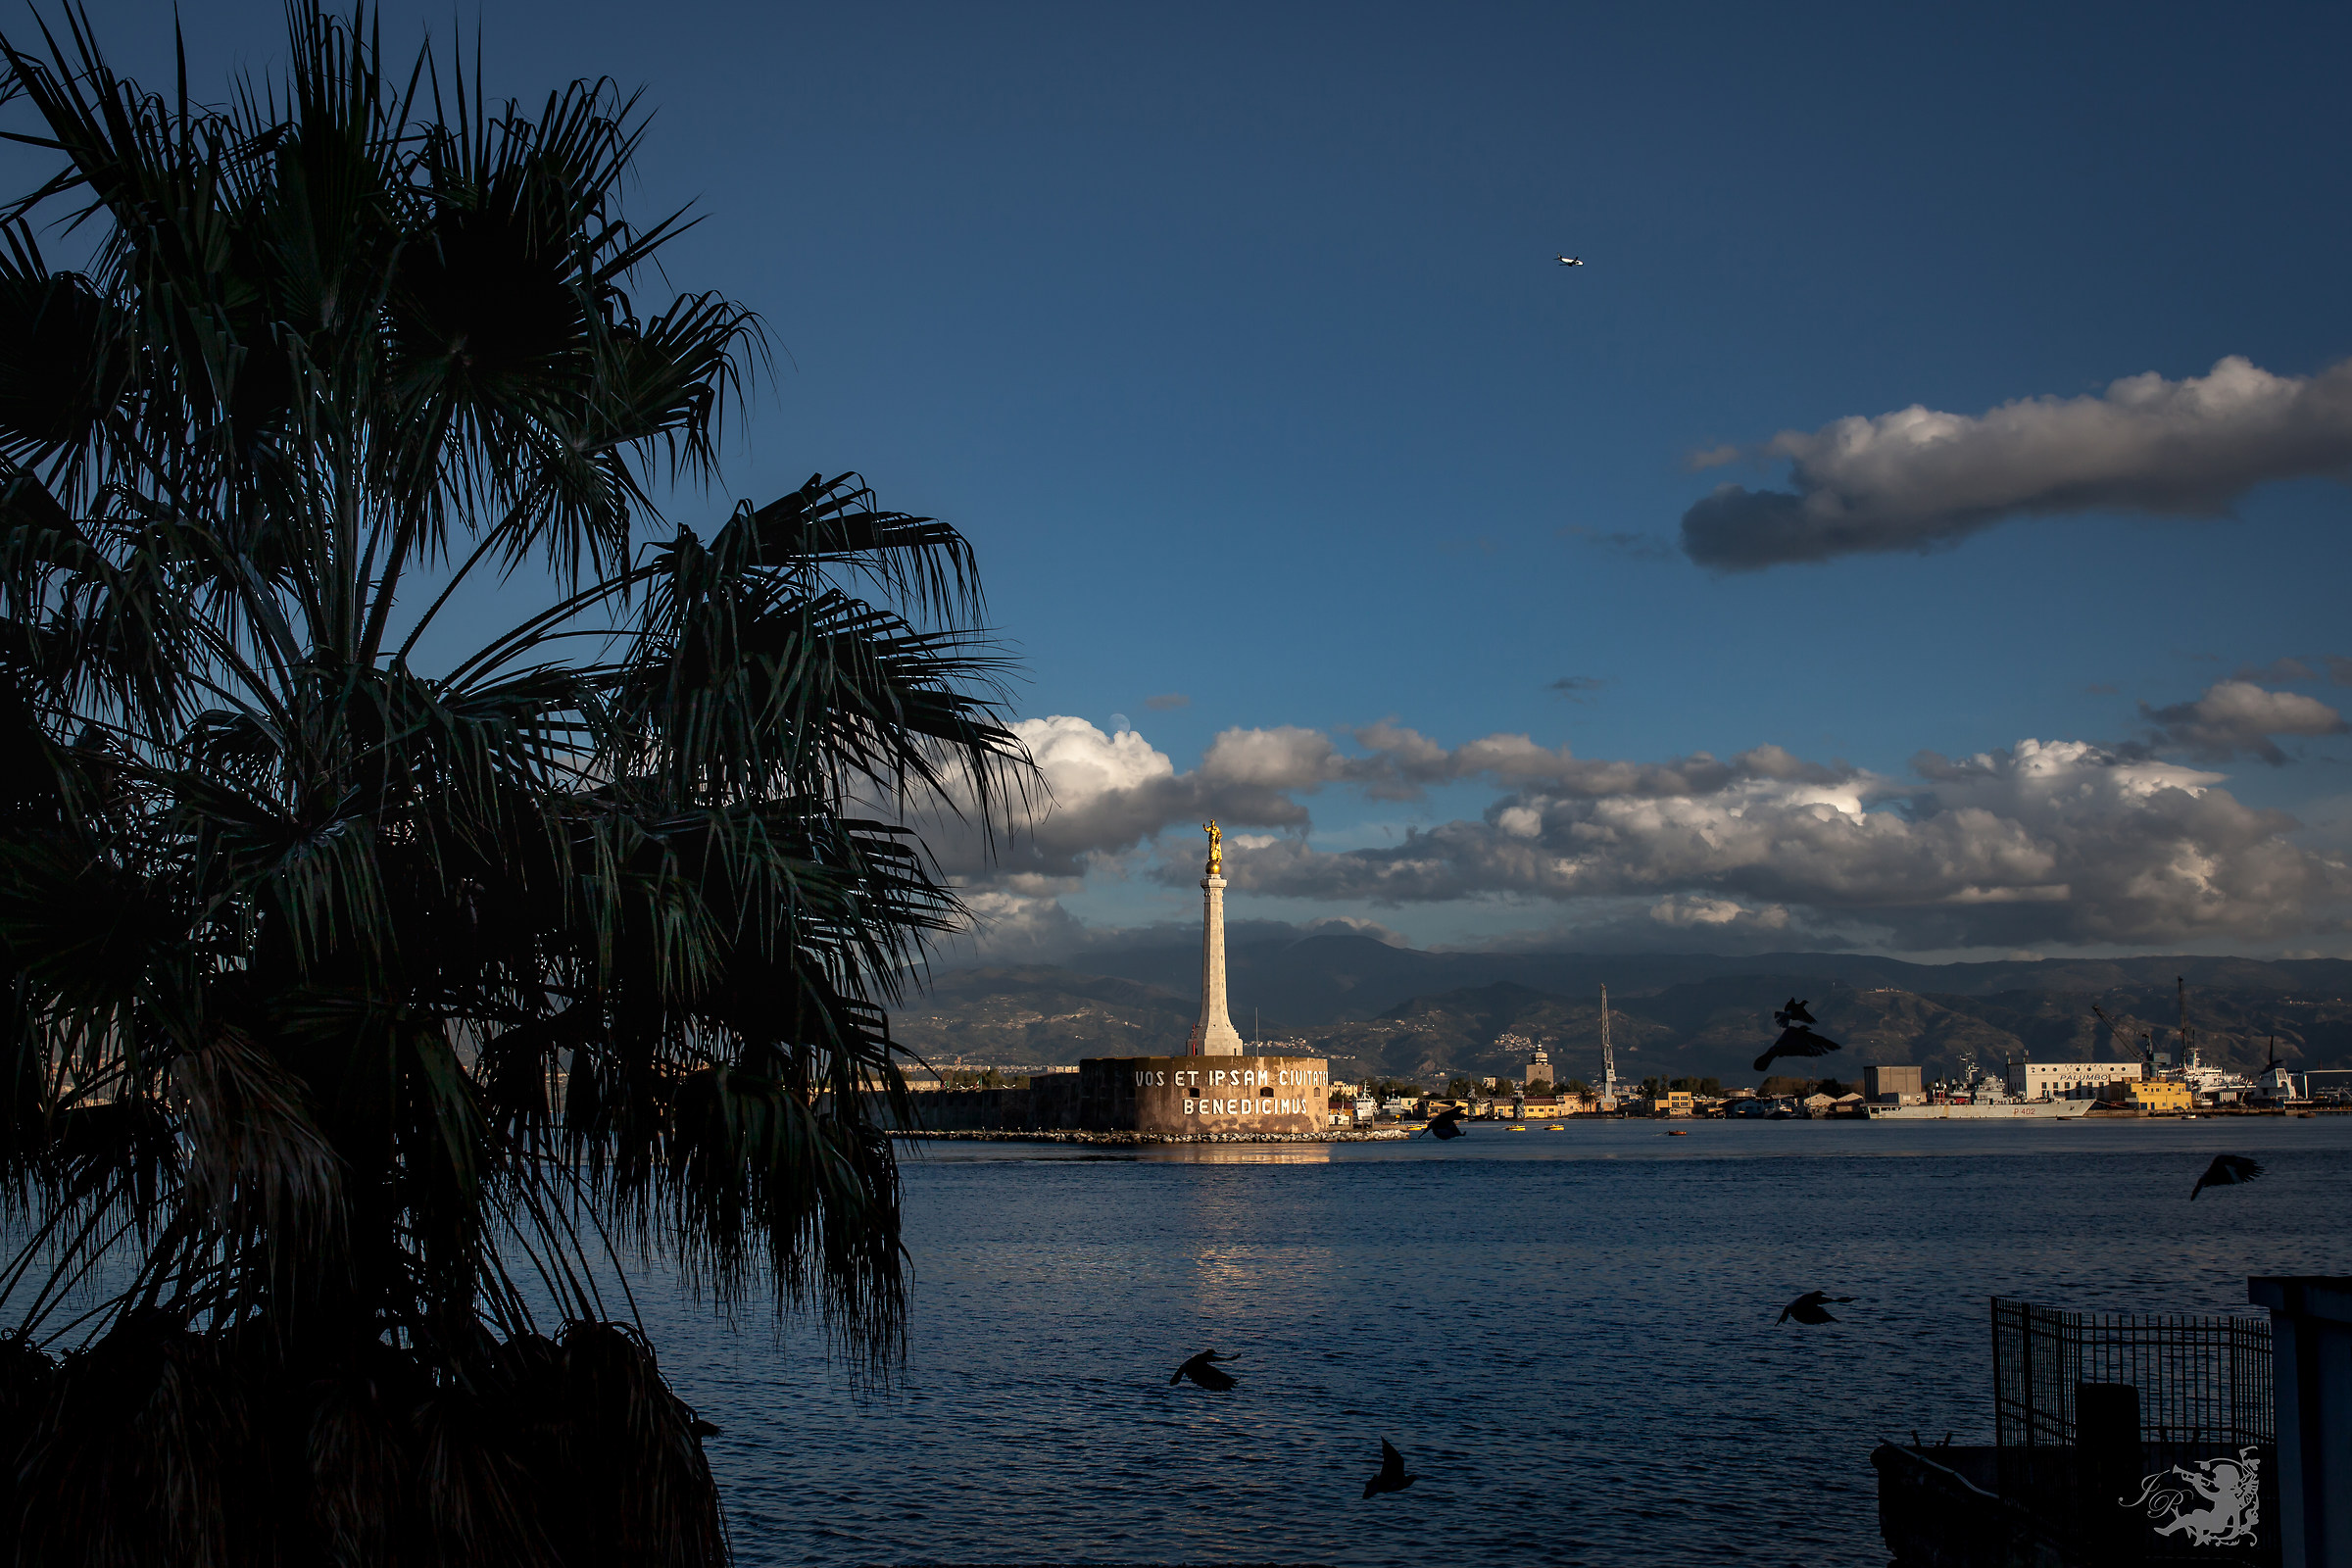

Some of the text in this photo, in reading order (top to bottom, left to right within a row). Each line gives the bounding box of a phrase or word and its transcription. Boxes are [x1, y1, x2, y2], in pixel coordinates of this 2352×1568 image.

[1135, 1070, 1165, 1087] VOS
[1174, 1070, 1200, 1087] ET
[1207, 1069, 1269, 1087] IPSAM
[1183, 1098, 1307, 1115] BENEDICIMUS
